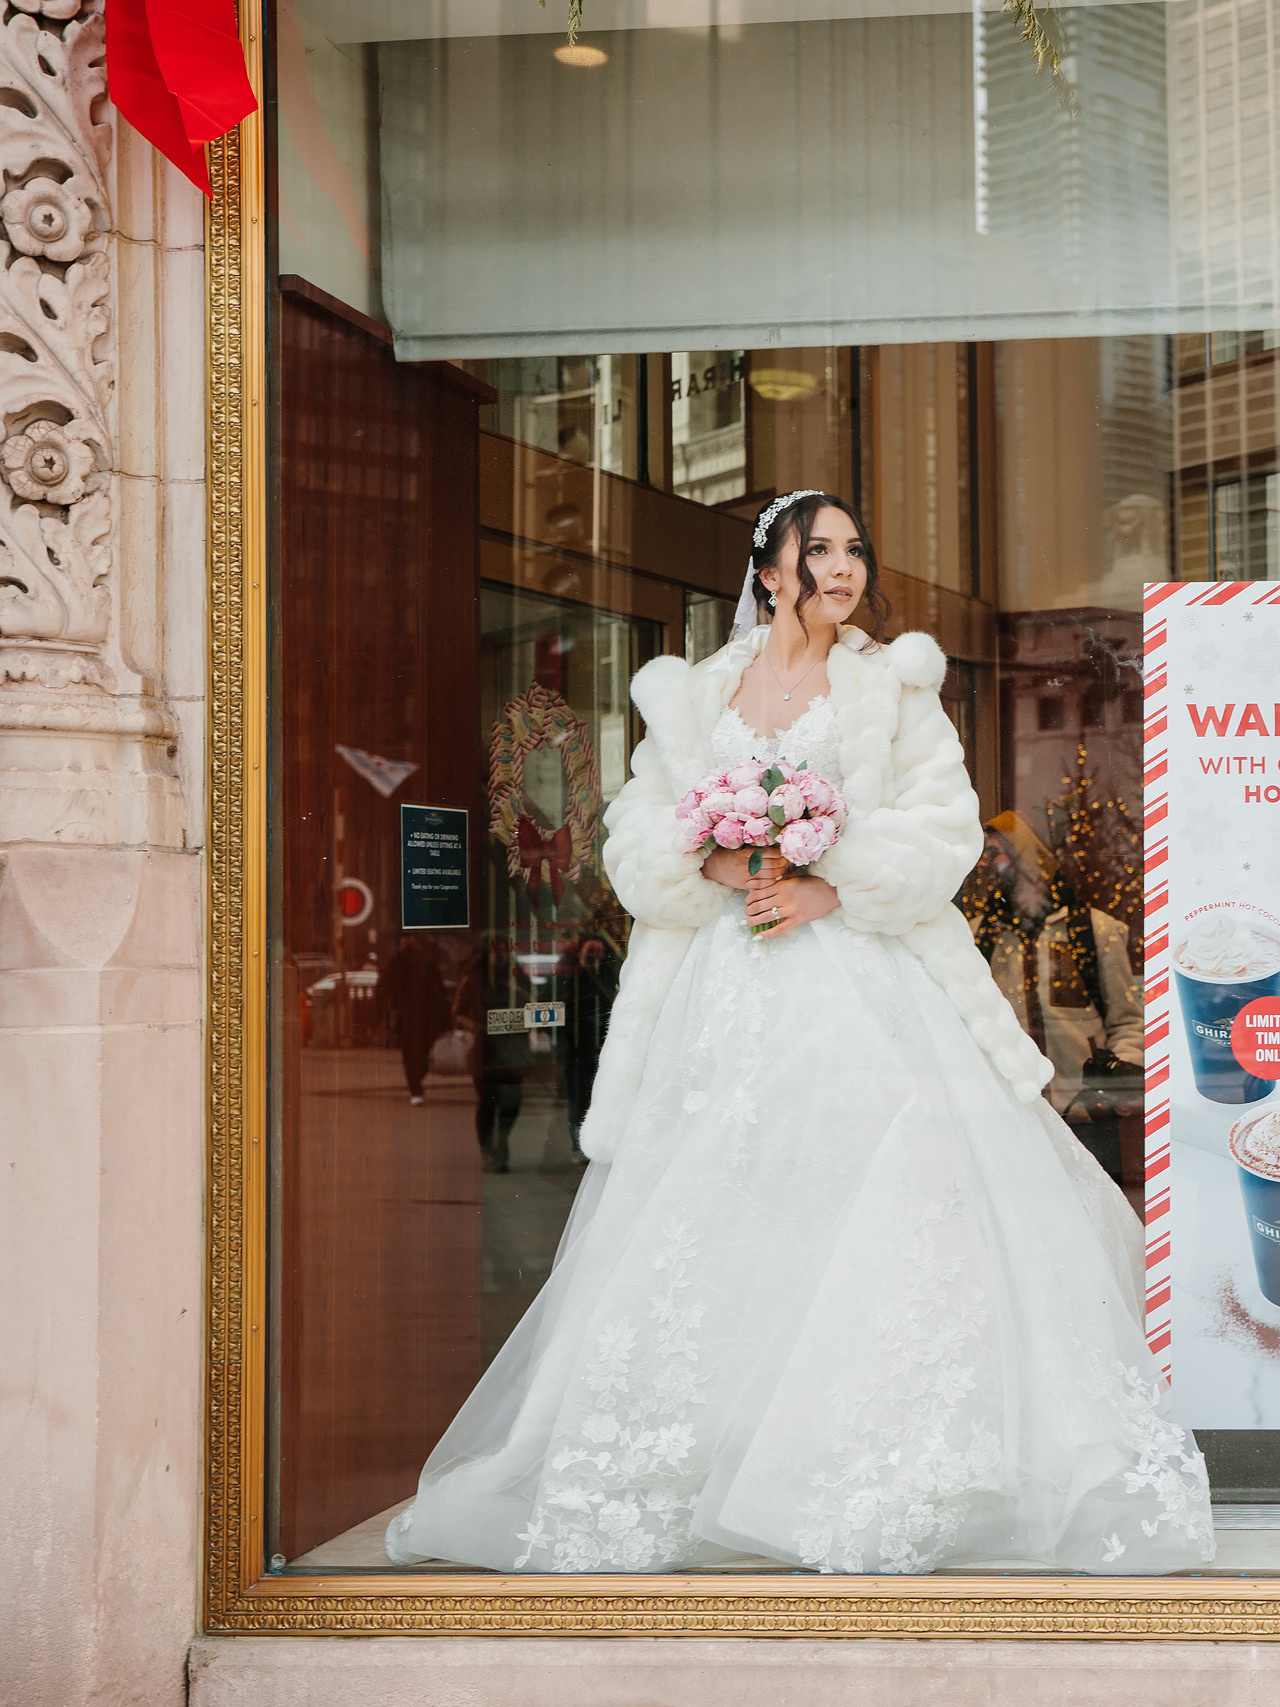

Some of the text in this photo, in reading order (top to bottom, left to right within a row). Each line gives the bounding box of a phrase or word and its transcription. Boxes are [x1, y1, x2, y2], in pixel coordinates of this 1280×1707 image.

[1199, 756, 1266, 775] WITH
[1184, 901, 1237, 922] PEPPERMINT
[1239, 902, 1256, 912] HOT
[488, 1012, 508, 1025] STAND
